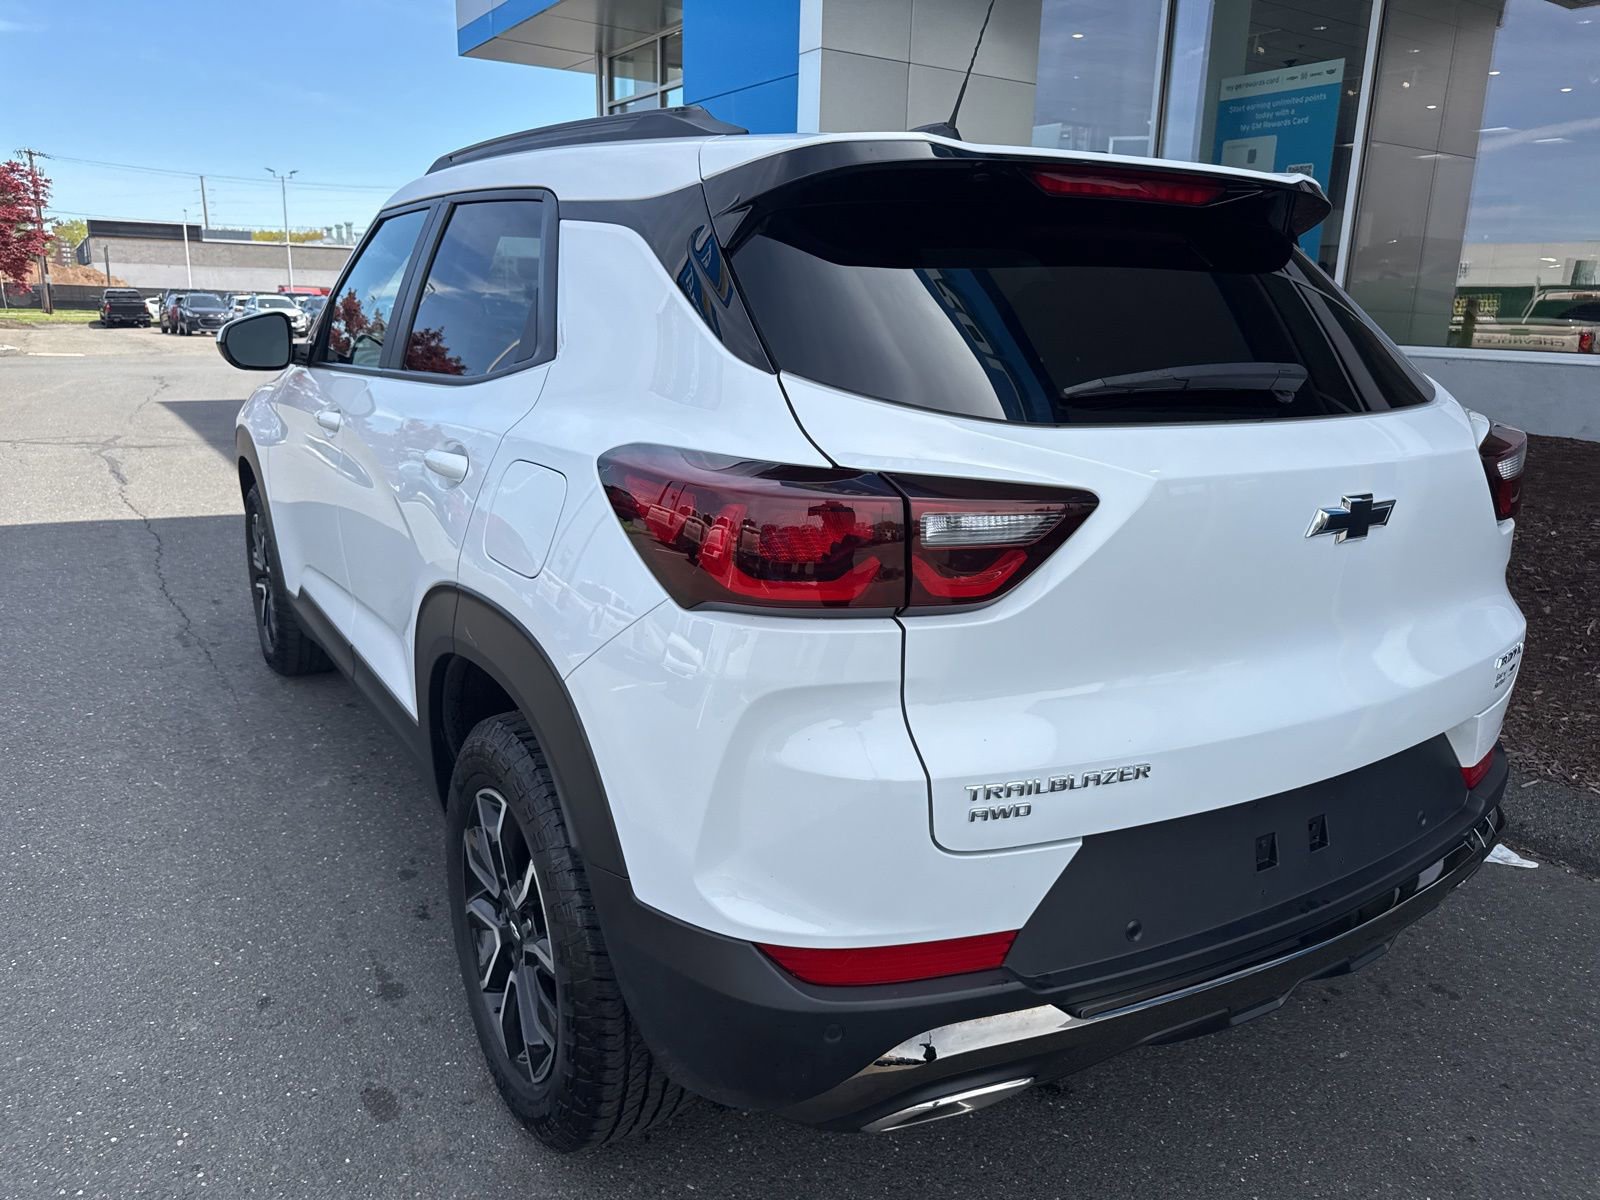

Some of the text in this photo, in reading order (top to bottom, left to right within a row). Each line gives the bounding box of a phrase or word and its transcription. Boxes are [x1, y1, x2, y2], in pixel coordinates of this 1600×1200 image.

[1266, 77, 1280, 86] card
[1229, 93, 1327, 114] Start earning unlimited points
[1251, 122, 1262, 130] GM
[1263, 119, 1291, 129] Rewards
[1292, 116, 1310, 125] Card
[1255, 111, 1273, 120] today
[1275, 109, 1290, 117] with
[964, 762, 1152, 802] TRAILBLAZER
[968, 801, 1032, 823] AWD
